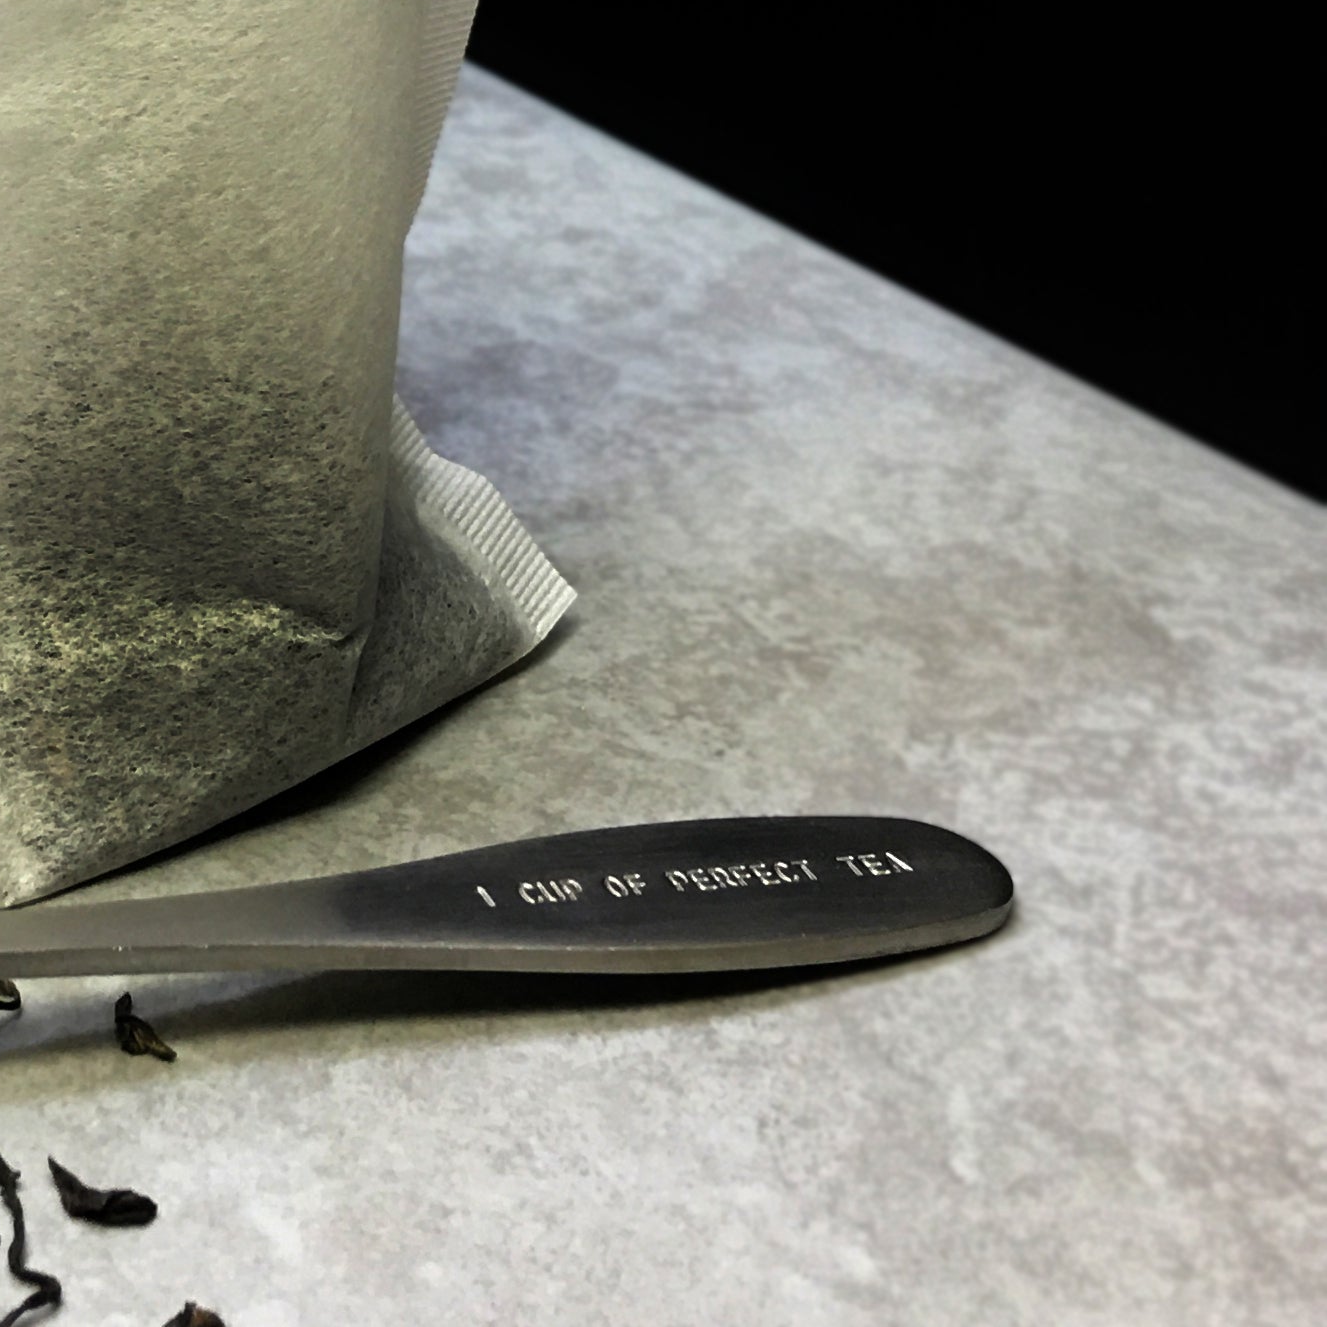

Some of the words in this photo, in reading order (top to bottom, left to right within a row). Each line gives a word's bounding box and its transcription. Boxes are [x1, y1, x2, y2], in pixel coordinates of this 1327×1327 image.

[518, 879, 583, 904] CUP
[603, 873, 647, 898] OF
[666, 859, 819, 892] PERFECT
[836, 852, 914, 876] TEA
